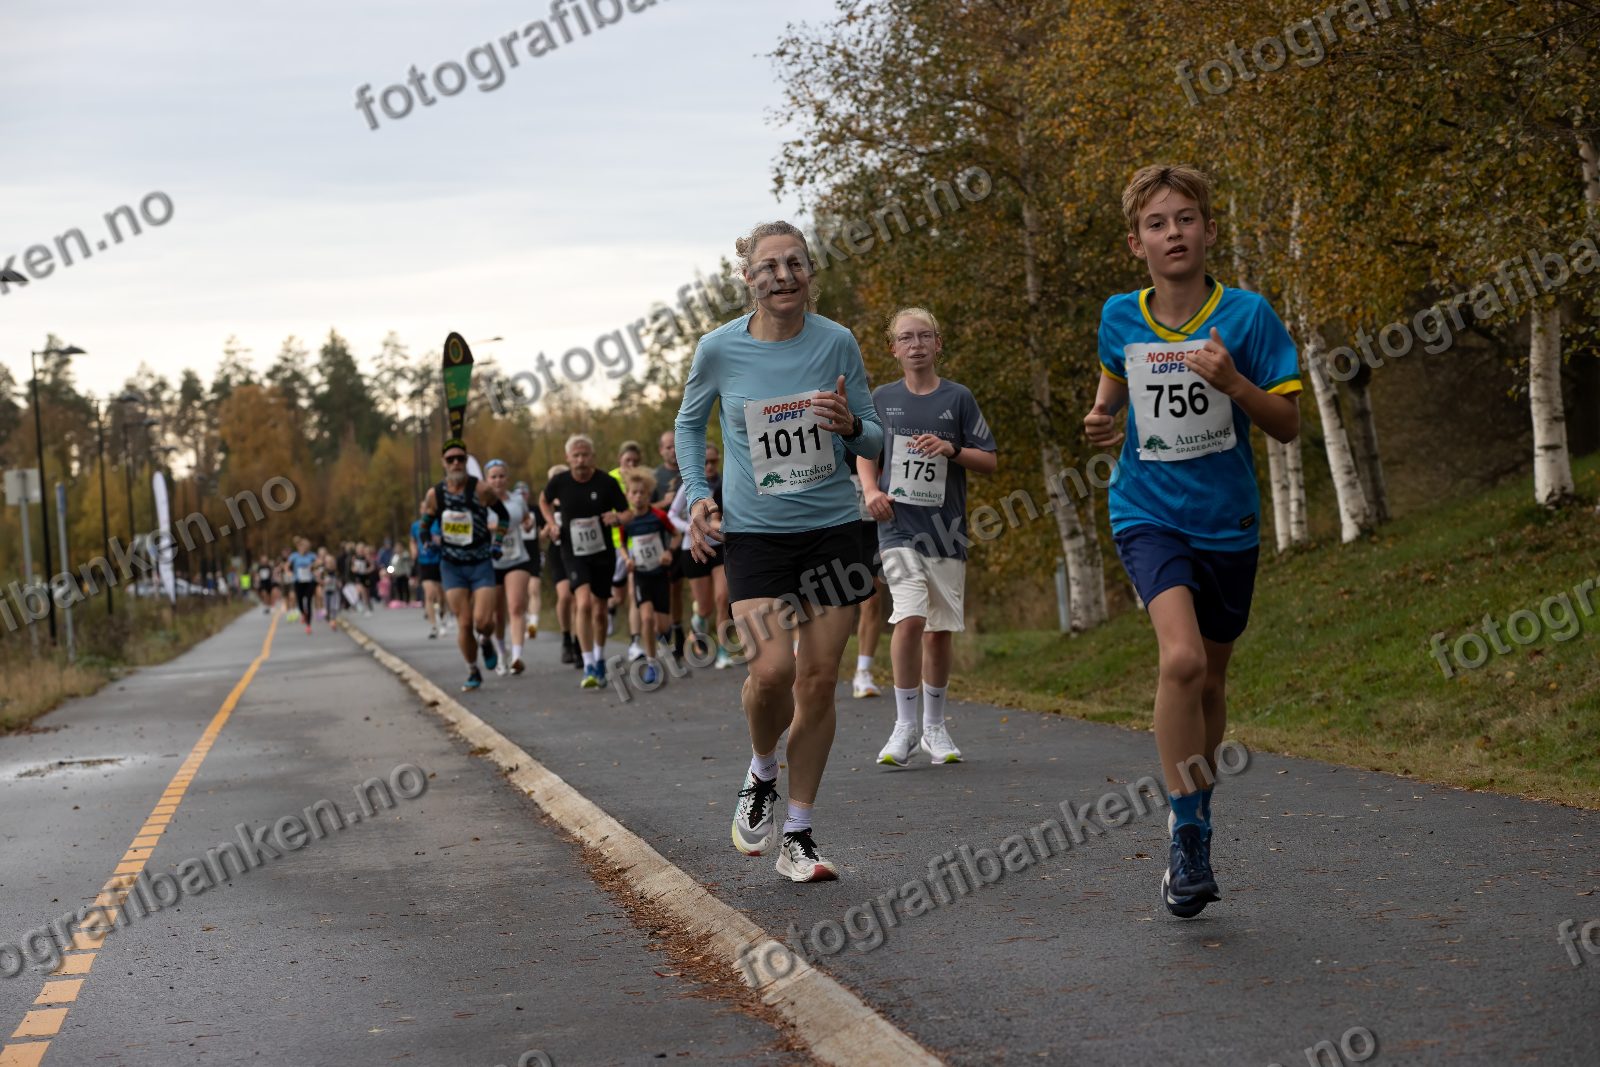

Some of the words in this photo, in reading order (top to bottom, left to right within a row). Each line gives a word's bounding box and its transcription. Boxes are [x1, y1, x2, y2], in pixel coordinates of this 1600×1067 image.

[1146, 348, 1203, 363] NORG
[1151, 361, 1192, 375] LØPE
[1146, 381, 1209, 418] 756
[762, 399, 811, 416] NORGES
[768, 409, 806, 424] LØPET
[758, 423, 821, 459] 1011
[1175, 426, 1232, 446] Aurskog
[790, 463, 833, 479] Aurskog
[902, 459, 936, 482] 175
[910, 489, 943, 501] Aurskog
[444, 522, 471, 535] PACE
[578, 529, 598, 542] 110
[640, 546, 658, 559] 151
